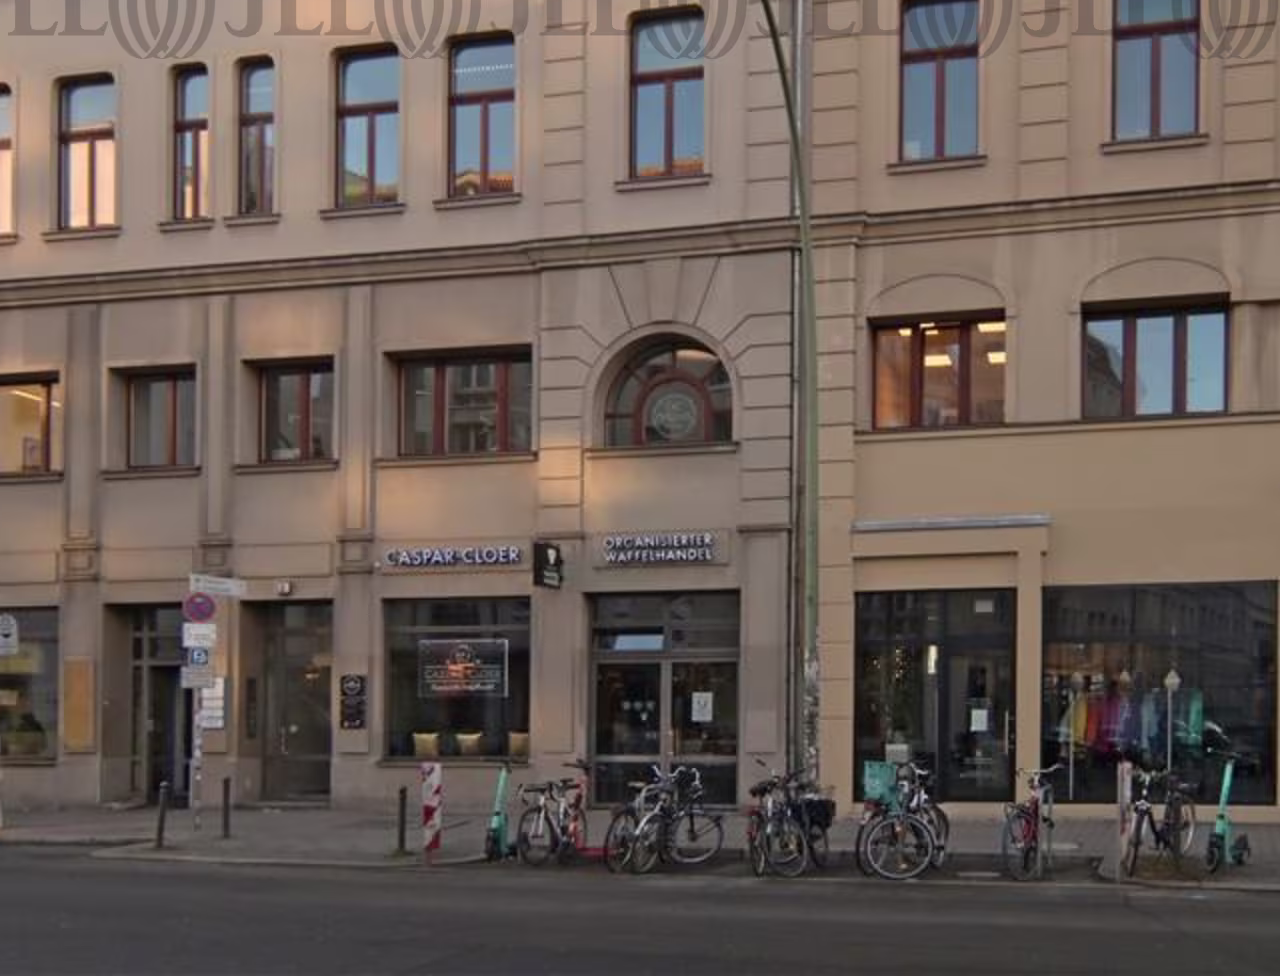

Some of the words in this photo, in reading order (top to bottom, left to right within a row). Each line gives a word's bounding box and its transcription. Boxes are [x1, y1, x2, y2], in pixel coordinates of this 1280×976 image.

[604, 533, 712, 549] ORGANISIERTER
[386, 547, 456, 565] CASPAR
[462, 545, 520, 564] CLOER
[606, 549, 712, 562] WAFFELHANDEL
